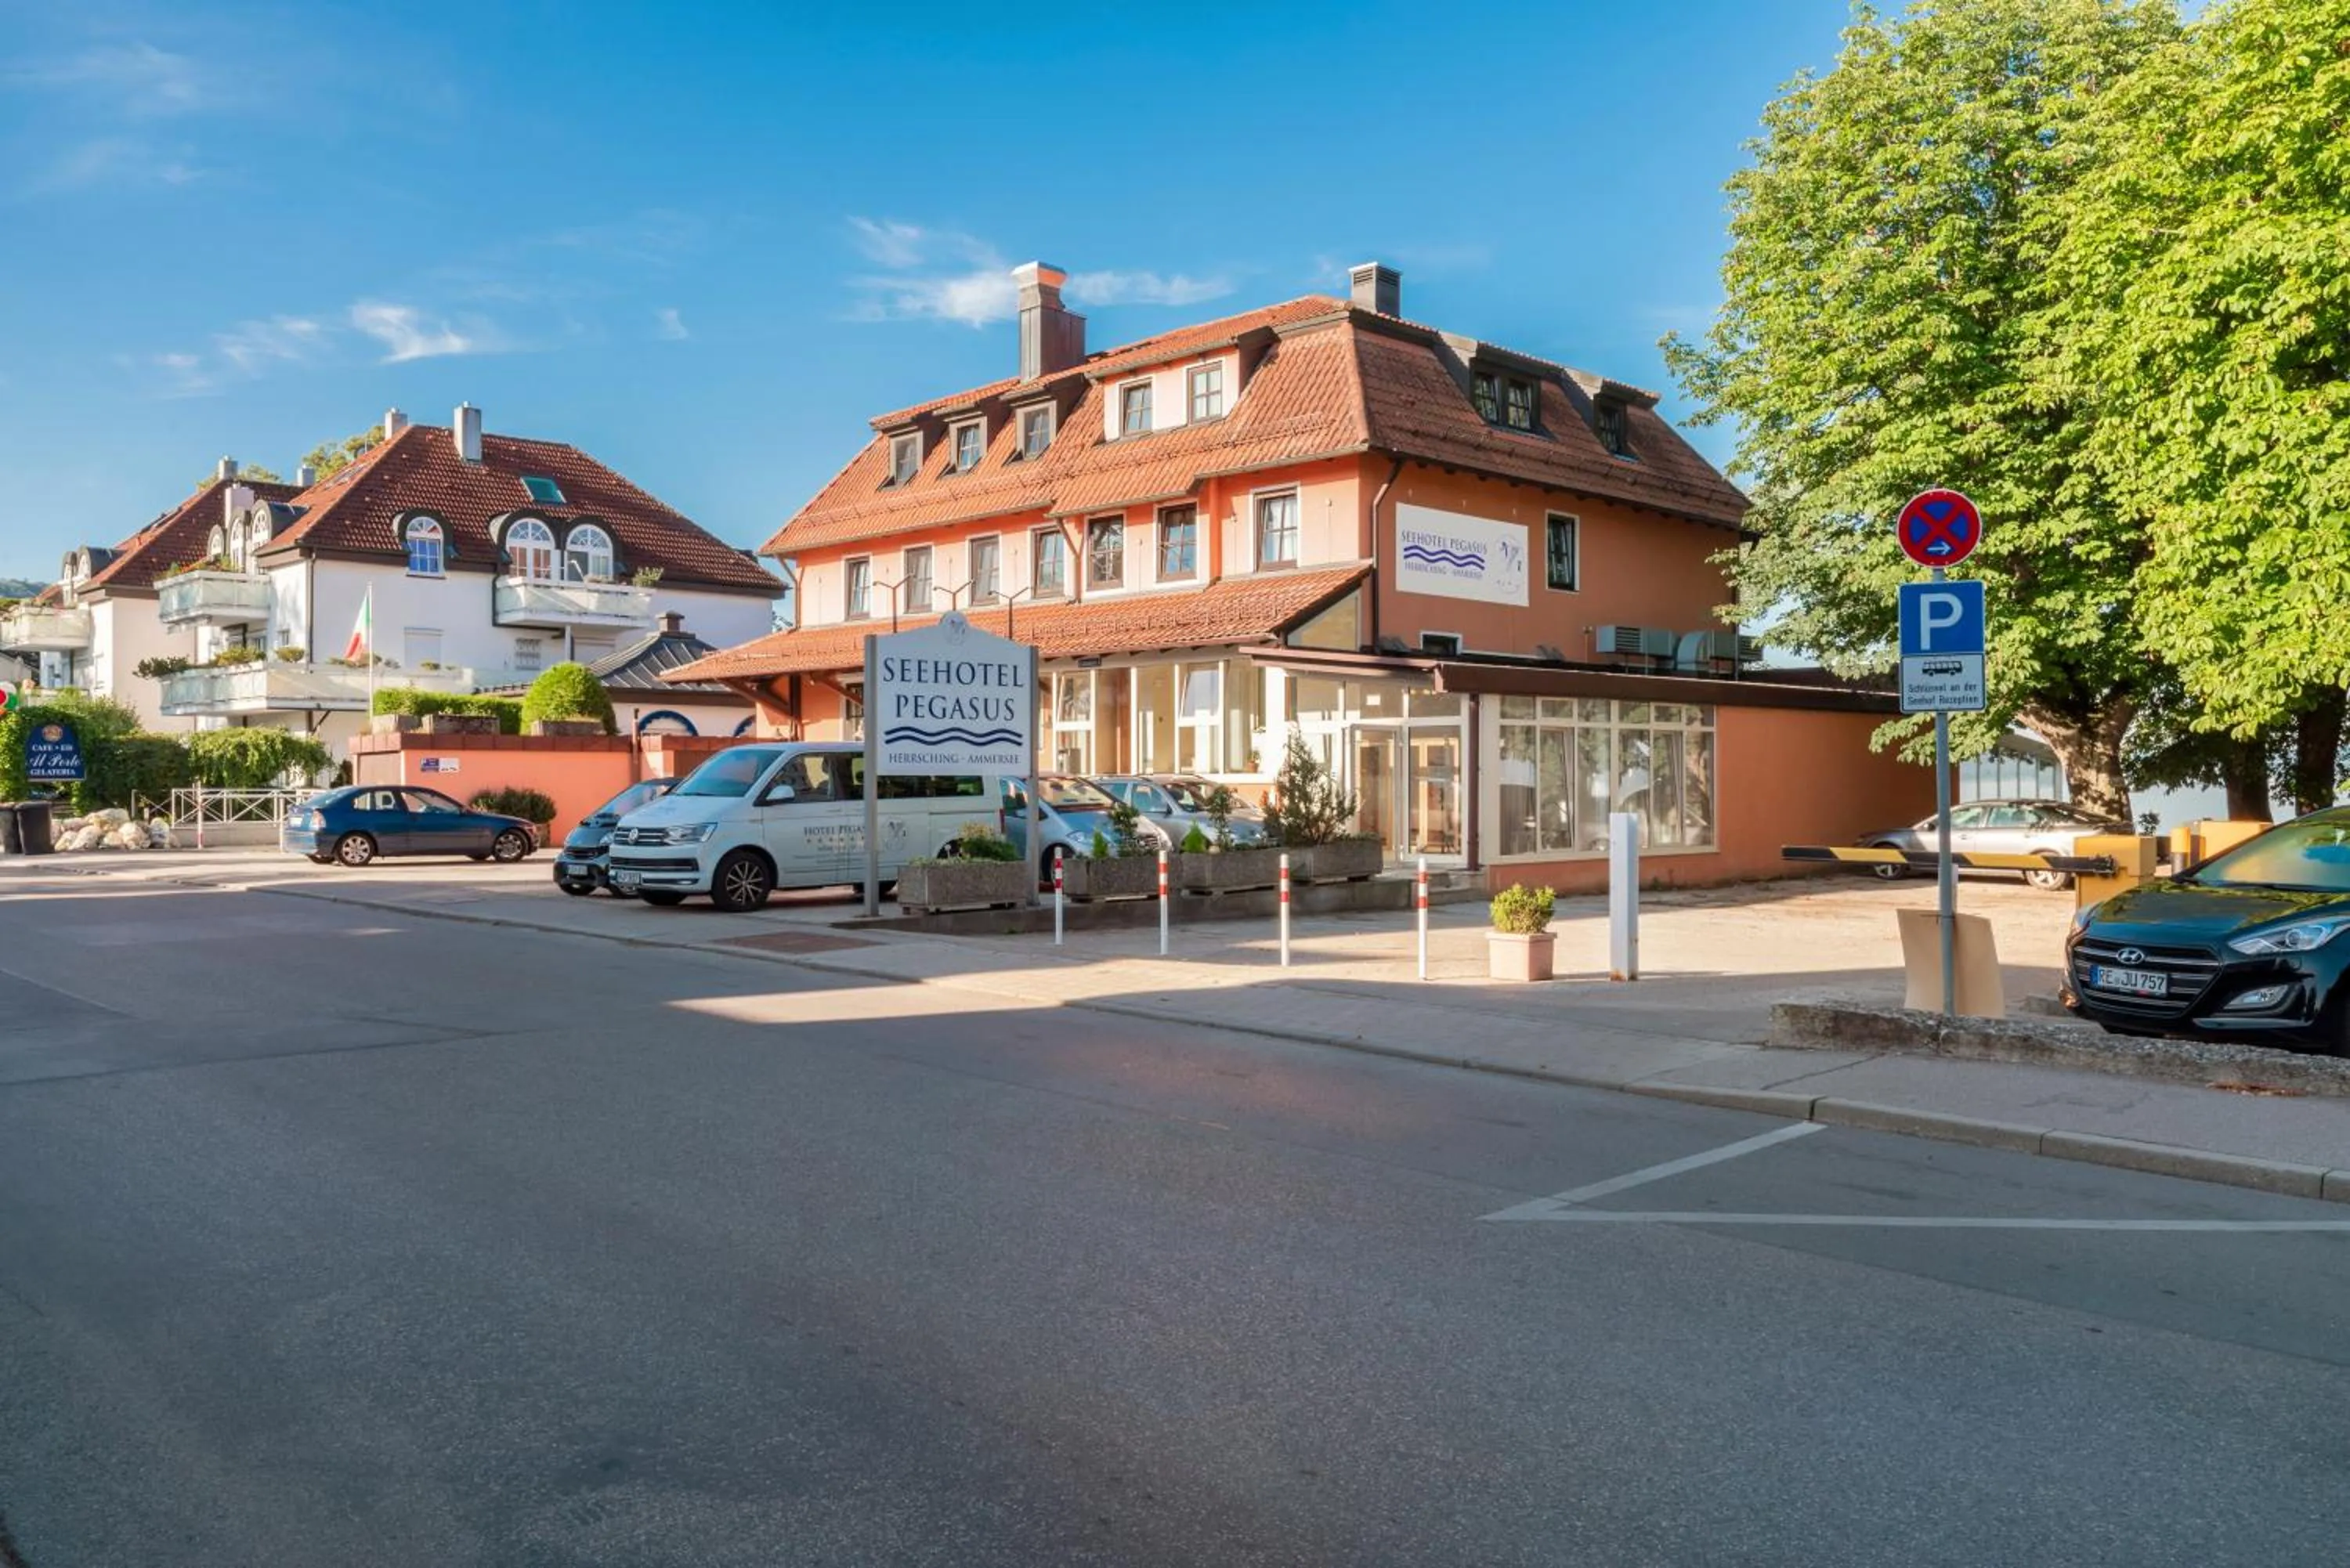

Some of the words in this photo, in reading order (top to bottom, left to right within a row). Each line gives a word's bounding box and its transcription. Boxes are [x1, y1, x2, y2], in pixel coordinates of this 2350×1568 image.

[1401, 529, 1448, 548] SEEHOTEL
[1450, 538, 1488, 555] PEGASUS
[1920, 593, 1964, 650] P
[882, 656, 1024, 688] SEEHOTEL
[895, 694, 1015, 721] PEGASUS
[888, 752, 960, 764] HERRSCHING
[967, 753, 1021, 764] AMMERSEE
[2140, 974, 2166, 991] 757
